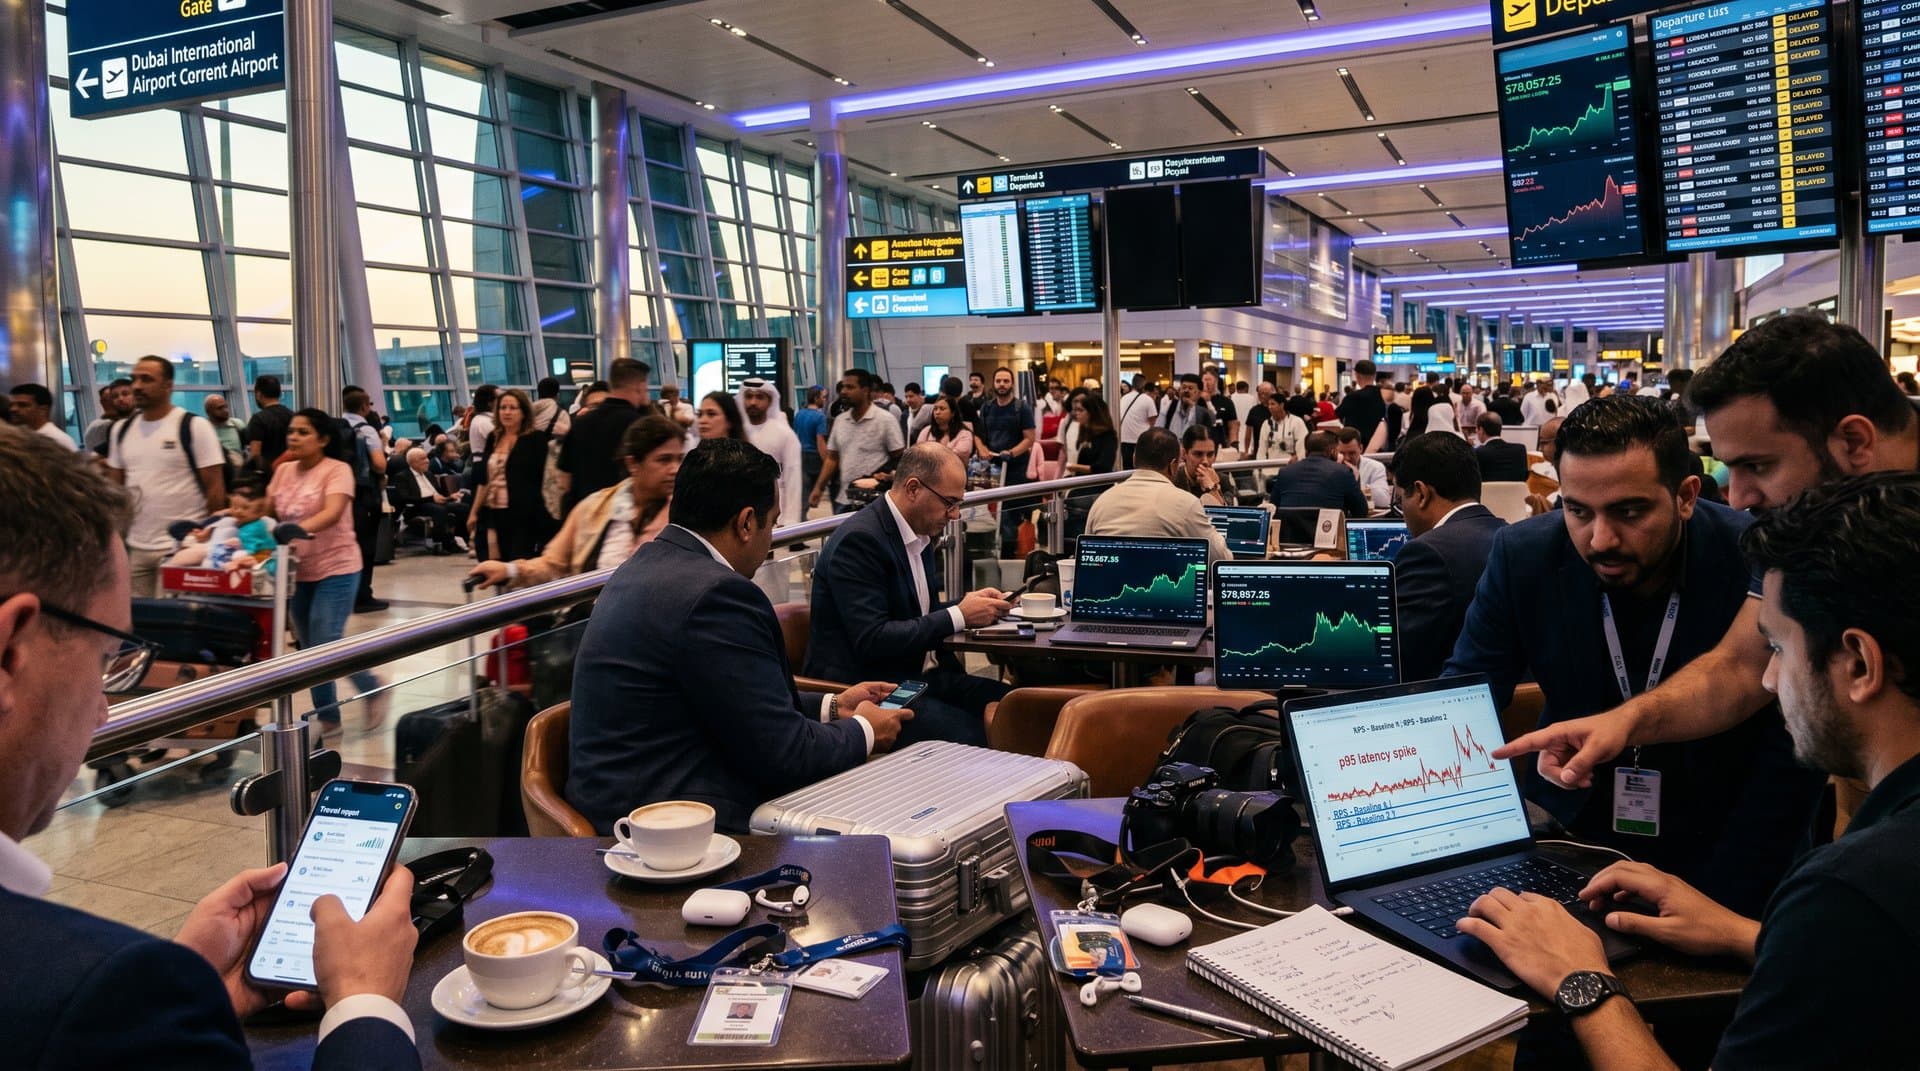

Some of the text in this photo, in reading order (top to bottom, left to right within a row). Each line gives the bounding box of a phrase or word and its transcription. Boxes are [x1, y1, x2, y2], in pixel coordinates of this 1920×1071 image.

[181, 0, 213, 17] Gate
[1655, 11, 1705, 30] Departure
[1789, 10, 1819, 21] DELAYED
[1790, 24, 1820, 33] DELAYED
[132, 30, 255, 72] Dubai International
[1791, 50, 1821, 60] DELAYED
[133, 71, 176, 95] Airport
[231, 52, 279, 79] Airport
[1792, 75, 1822, 84] DELAYED
[1793, 87, 1823, 97] DELAYED
[1793, 101, 1823, 111] DELAYED
[1794, 114, 1824, 123] DELAYED
[1795, 127, 1824, 136] DELAYED
[1796, 153, 1825, 162] DELAYED
[1796, 166, 1825, 174] DELAYED
[1797, 178, 1826, 187] DELAYED
[1358, 751, 1390, 765] latency
[1393, 745, 1417, 761] spike
[1333, 808, 1349, 820] RPS
[1336, 819, 1352, 830] RPS
